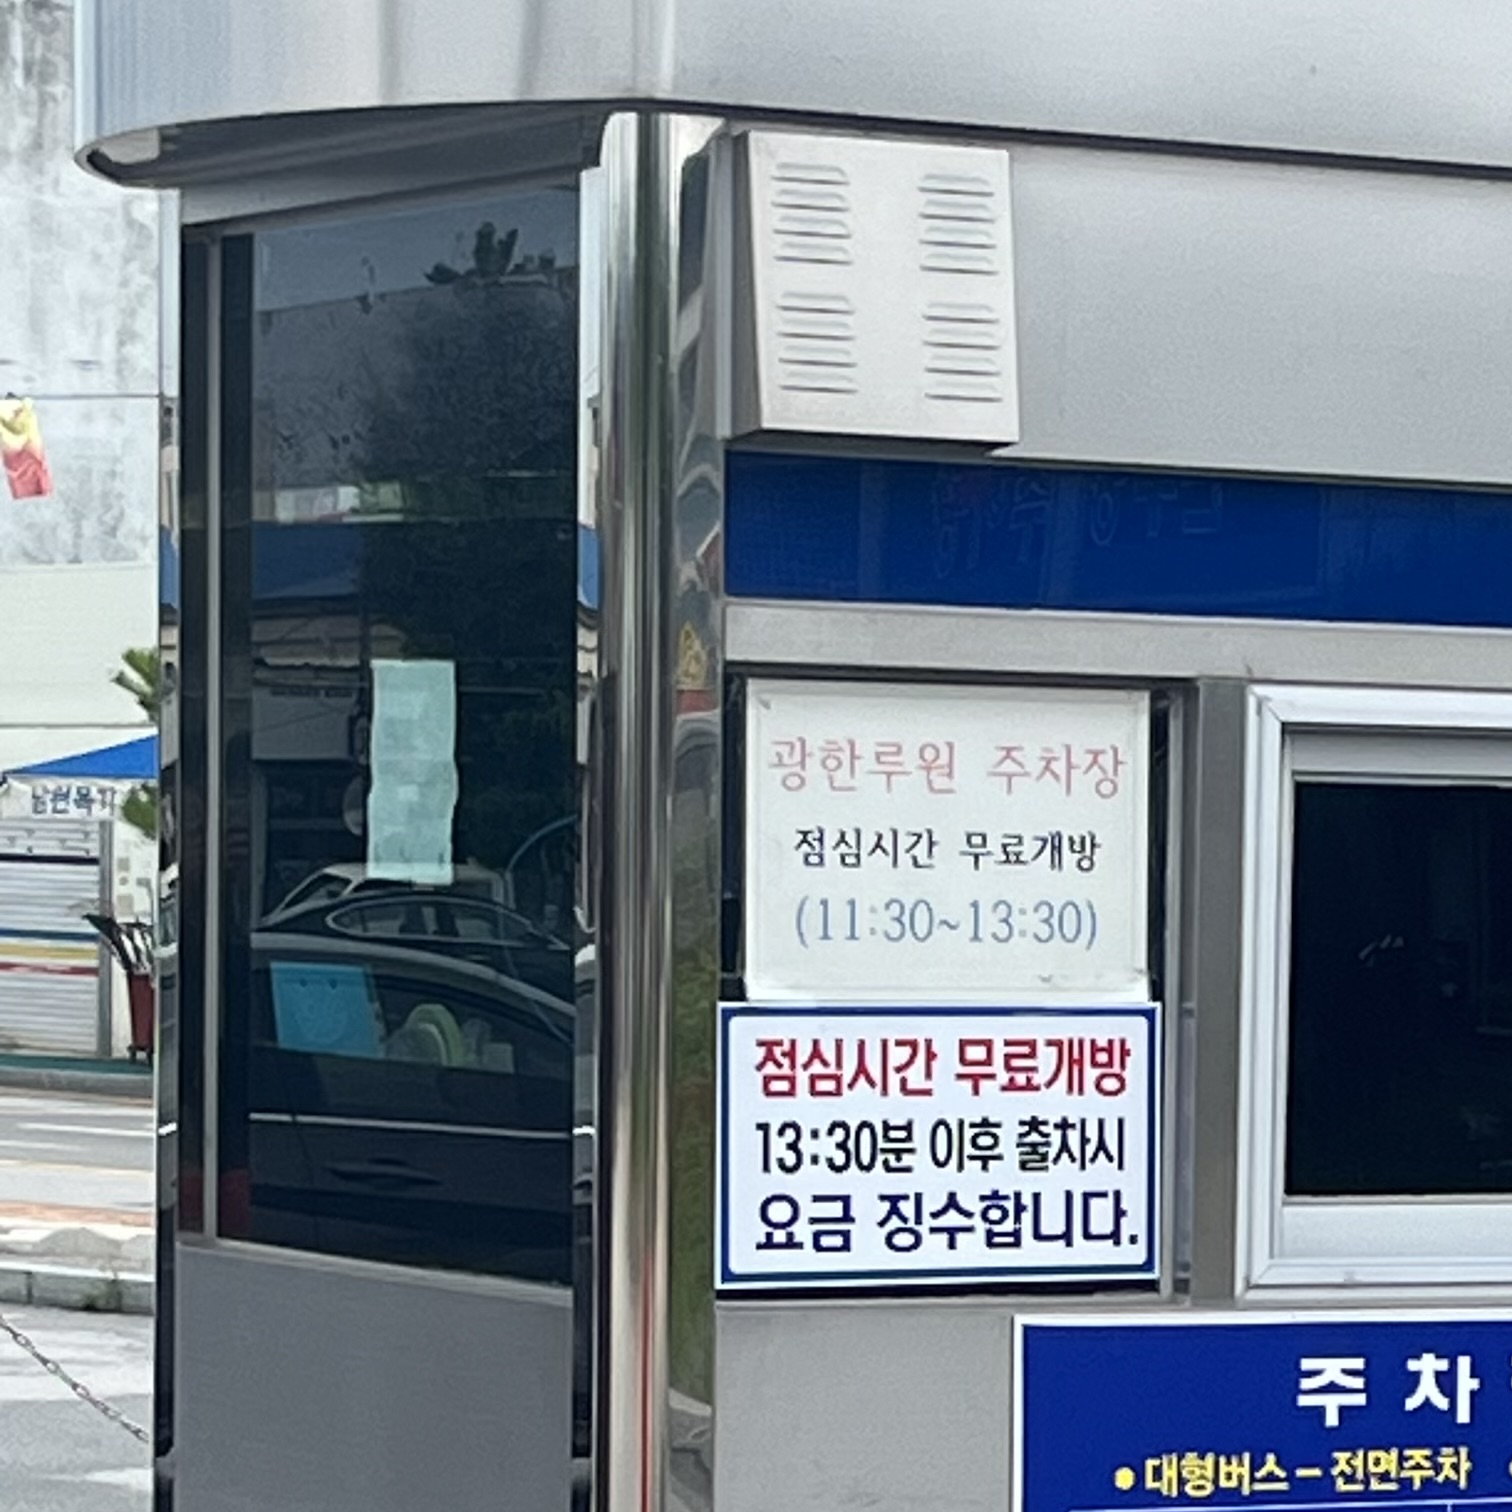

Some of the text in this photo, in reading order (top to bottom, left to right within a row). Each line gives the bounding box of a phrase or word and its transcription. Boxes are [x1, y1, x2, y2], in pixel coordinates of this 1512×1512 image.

[768, 736, 1128, 800] 광한루원 주차장
[794, 826, 1102, 873] 점심시간 무료개방
[794, 894, 1098, 952] (11:30~13:30)
[755, 1037, 1131, 1098] 점심시간 무료개방
[755, 1115, 1125, 1174] 13:30분 이후 출차시
[755, 1189, 1139, 1253] 요금 징수합니다.
